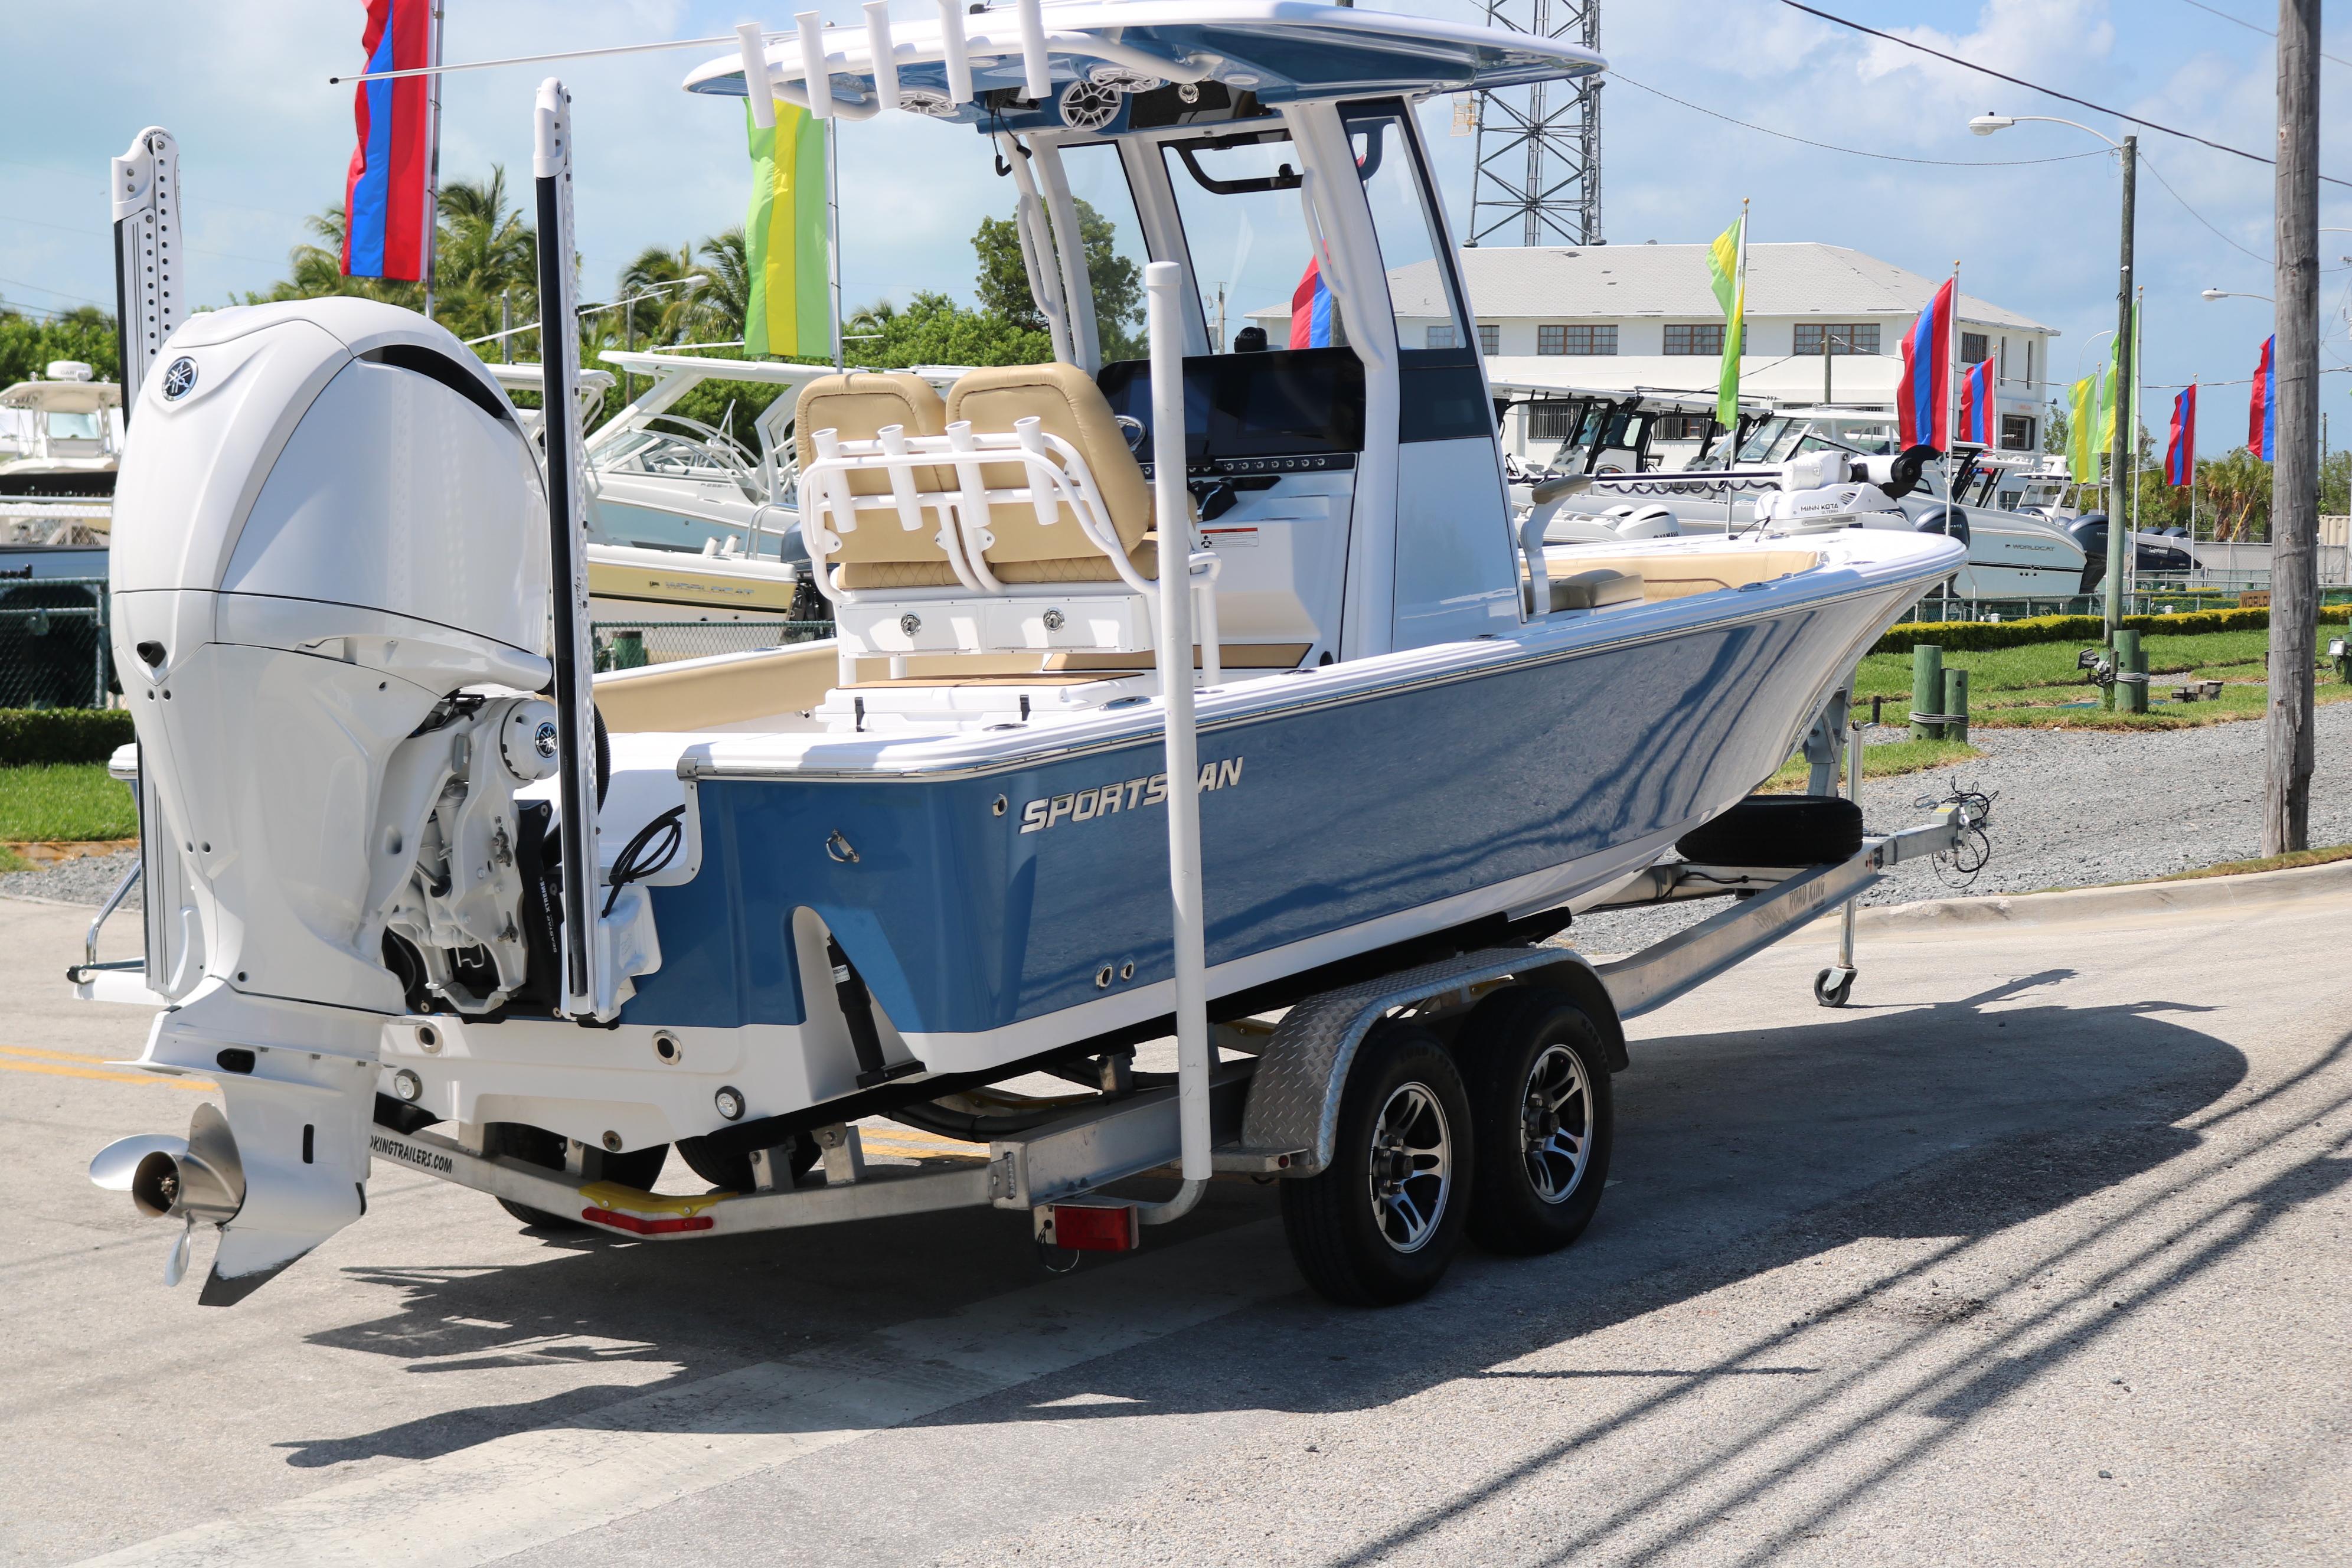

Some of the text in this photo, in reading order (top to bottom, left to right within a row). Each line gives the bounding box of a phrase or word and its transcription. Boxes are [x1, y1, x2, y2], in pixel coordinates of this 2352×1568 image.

[1019, 756, 1243, 834] SPORTSAN
[540, 880, 557, 953] SEASTAR XTREME
[1788, 875, 1825, 914] ROAD KING
